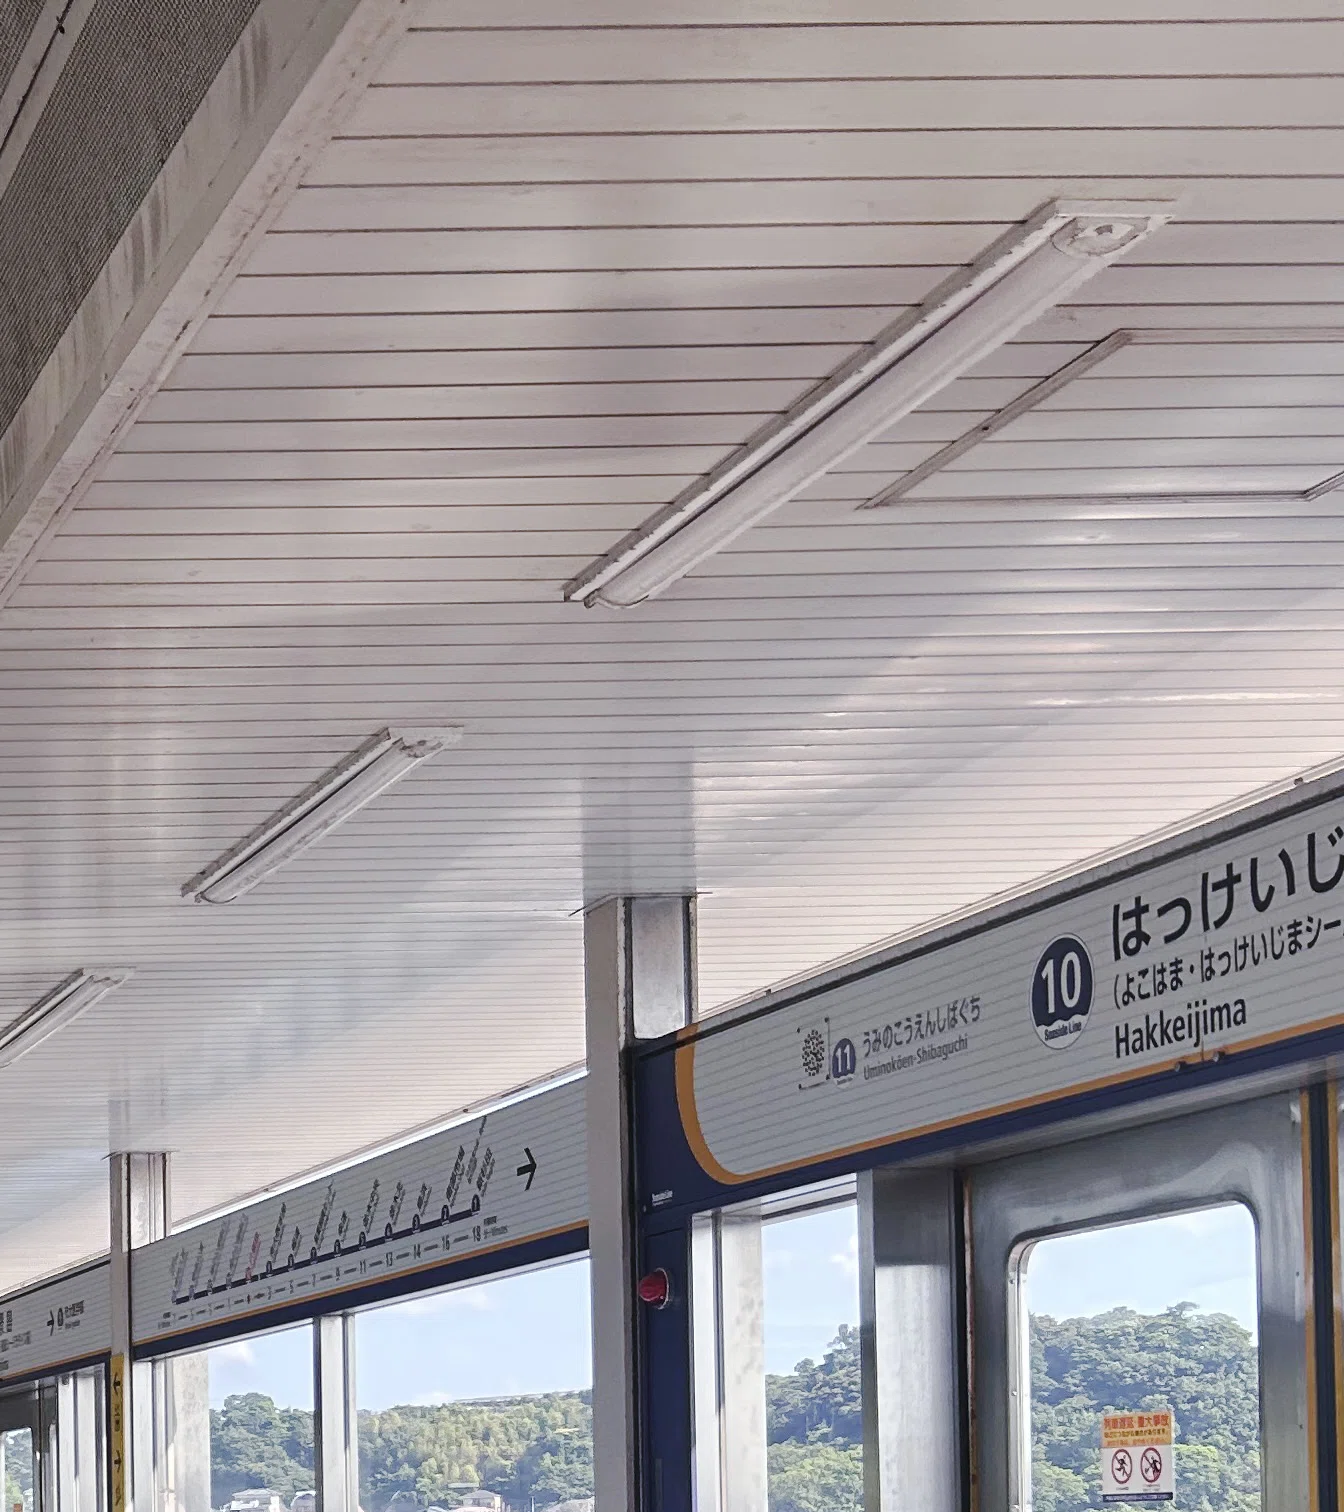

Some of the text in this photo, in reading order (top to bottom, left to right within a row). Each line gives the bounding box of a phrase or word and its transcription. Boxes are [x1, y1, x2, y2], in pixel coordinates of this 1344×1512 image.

[1112, 826, 1344, 961] はっけいじ
[1041, 951, 1081, 1014] 10
[1114, 915, 1344, 1011] (よこはま・はっけいじまシー
[863, 996, 980, 1058] うみのこうえんしばぐち
[1116, 999, 1247, 1058] Hakkeijima
[836, 1044, 851, 1073] 11
